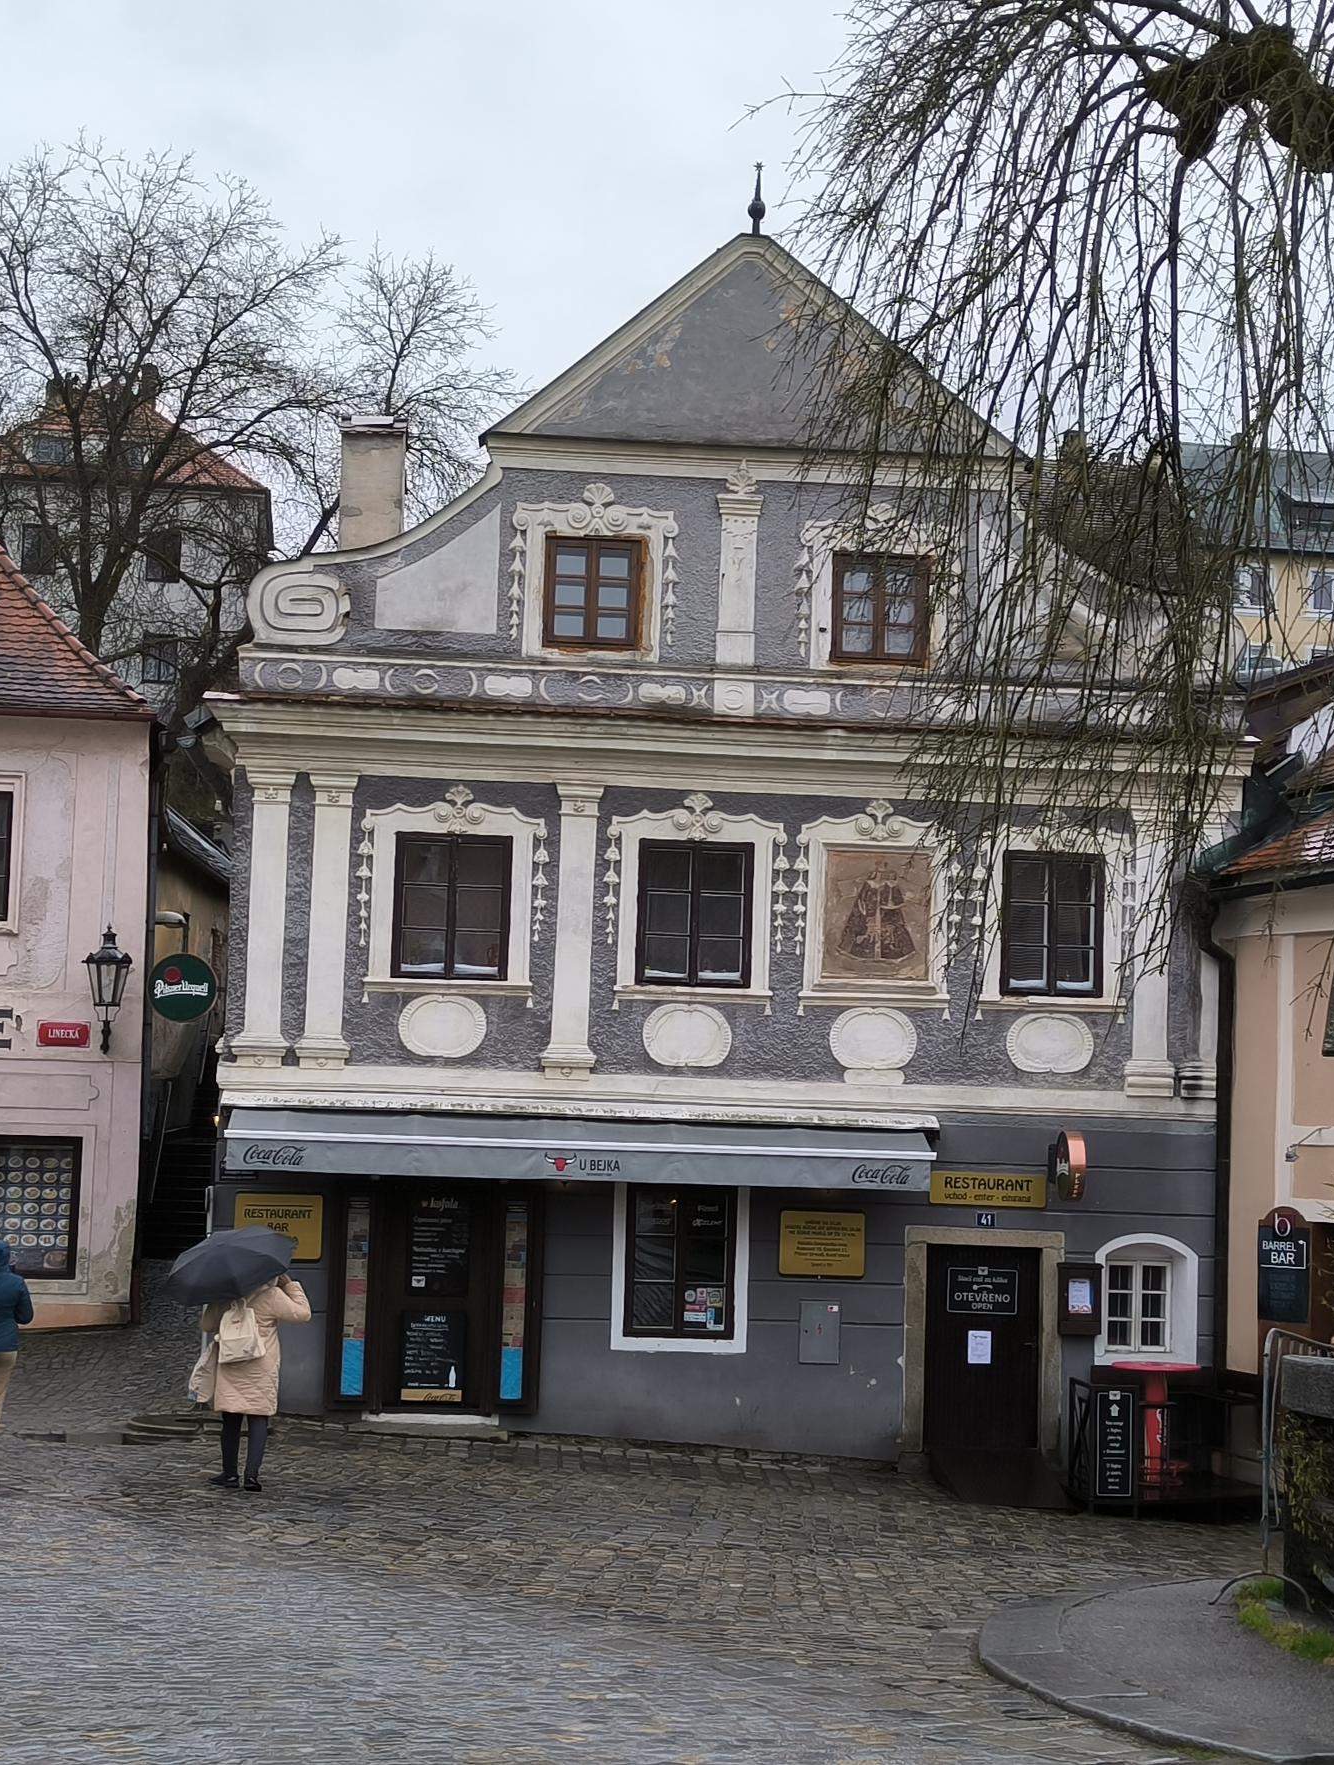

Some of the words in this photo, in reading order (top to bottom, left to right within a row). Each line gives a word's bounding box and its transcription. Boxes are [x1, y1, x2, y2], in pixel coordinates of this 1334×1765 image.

[48, 1028, 80, 1039] LINECKÁ
[579, 1158, 587, 1171] U
[590, 1159, 621, 1172] BEJKA
[944, 1176, 1033, 1191] RESTAURANT
[944, 1191, 967, 1200] vchod
[974, 1193, 996, 1201] enter
[244, 1208, 313, 1219] RESTAURANT
[980, 1214, 991, 1225] 41
[1262, 1240, 1297, 1252] BARREL
[1271, 1251, 1295, 1265] BAR
[954, 1291, 1011, 1303] OTEVŘENO
[971, 1302, 994, 1311] OPEN
